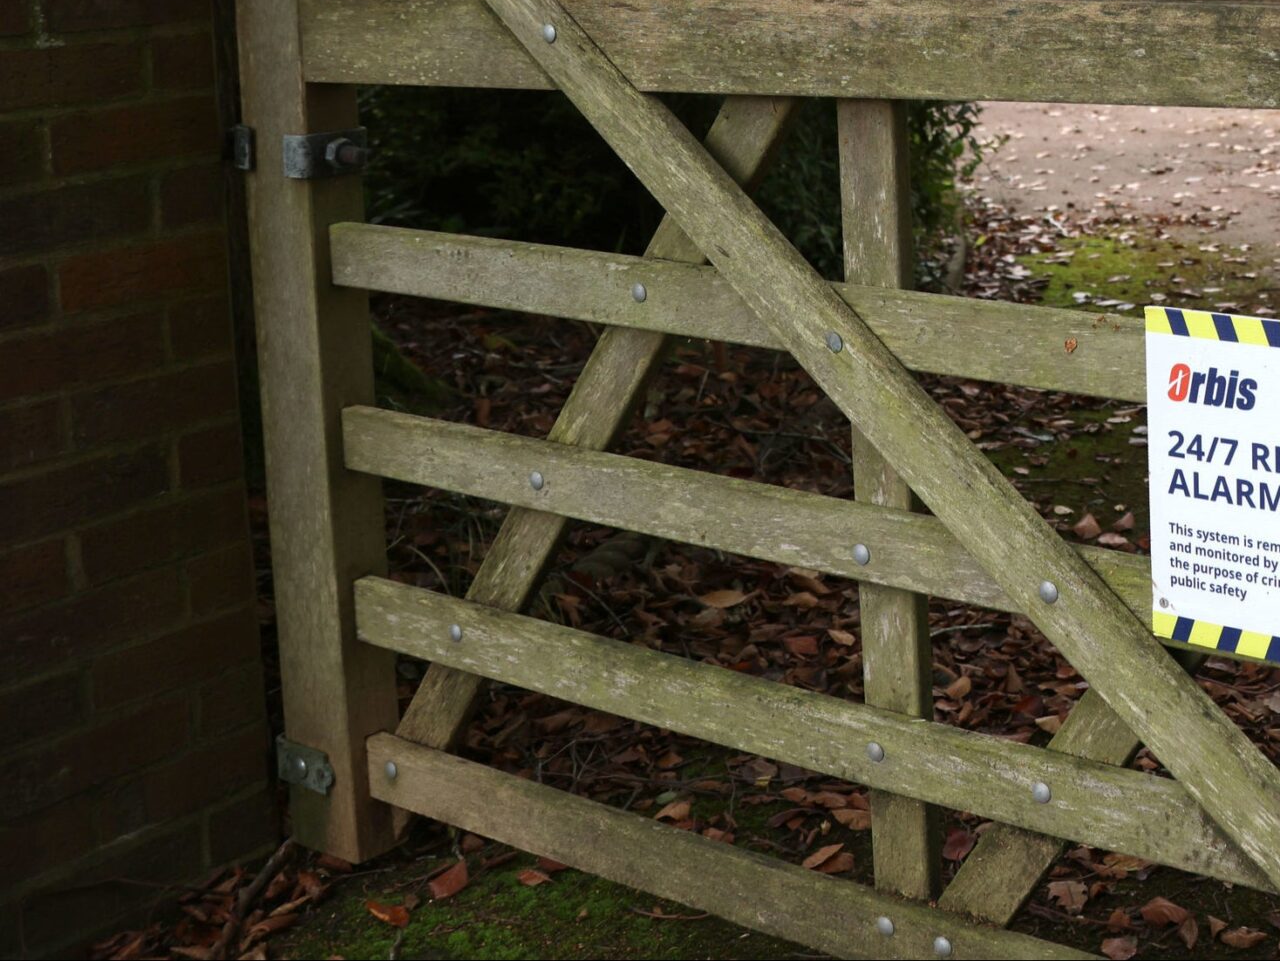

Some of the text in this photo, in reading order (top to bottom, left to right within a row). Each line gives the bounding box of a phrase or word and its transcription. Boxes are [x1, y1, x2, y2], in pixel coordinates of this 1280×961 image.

[1168, 364, 1258, 411] Orbis
[1168, 430, 1238, 466] 24/7
[1169, 522, 1193, 537] This
[1196, 530, 1239, 545] system
[1244, 535, 1253, 548] is
[1169, 542, 1191, 554] and
[1195, 547, 1259, 567] monitored
[1264, 556, 1278, 573] by
[1170, 557, 1189, 570] the
[1193, 563, 1242, 581] purpose
[1246, 572, 1259, 583] of
[1170, 575, 1247, 601] public safety
